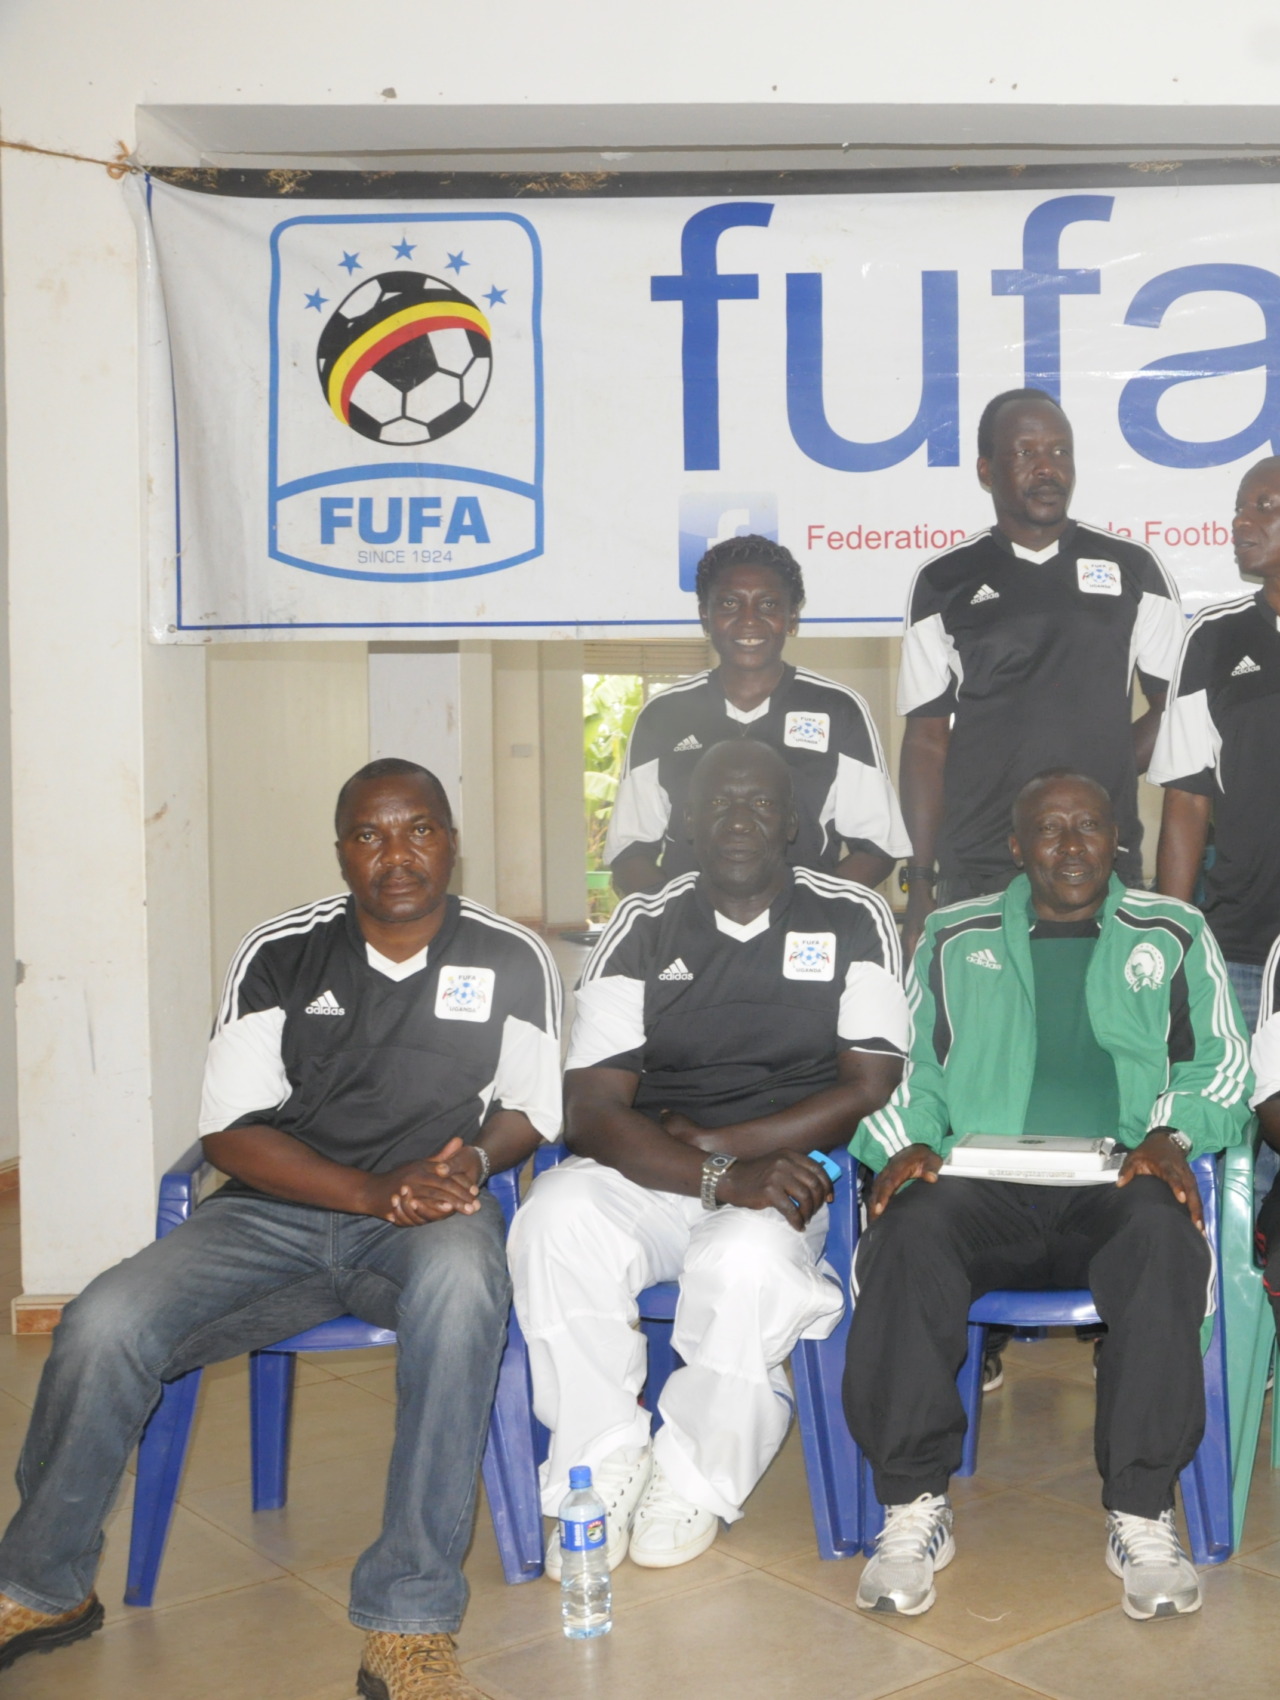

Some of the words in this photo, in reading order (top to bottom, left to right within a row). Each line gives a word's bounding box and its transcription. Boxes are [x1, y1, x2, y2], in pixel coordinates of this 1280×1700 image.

[320, 496, 491, 544] FUFA
[808, 524, 966, 550] Federation
[358, 550, 405, 563] SINCE
[412, 550, 453, 563] 1924
[1231, 665, 1261, 676] adidas
[966, 956, 1002, 970] adidas
[305, 1007, 345, 1015] adidas
